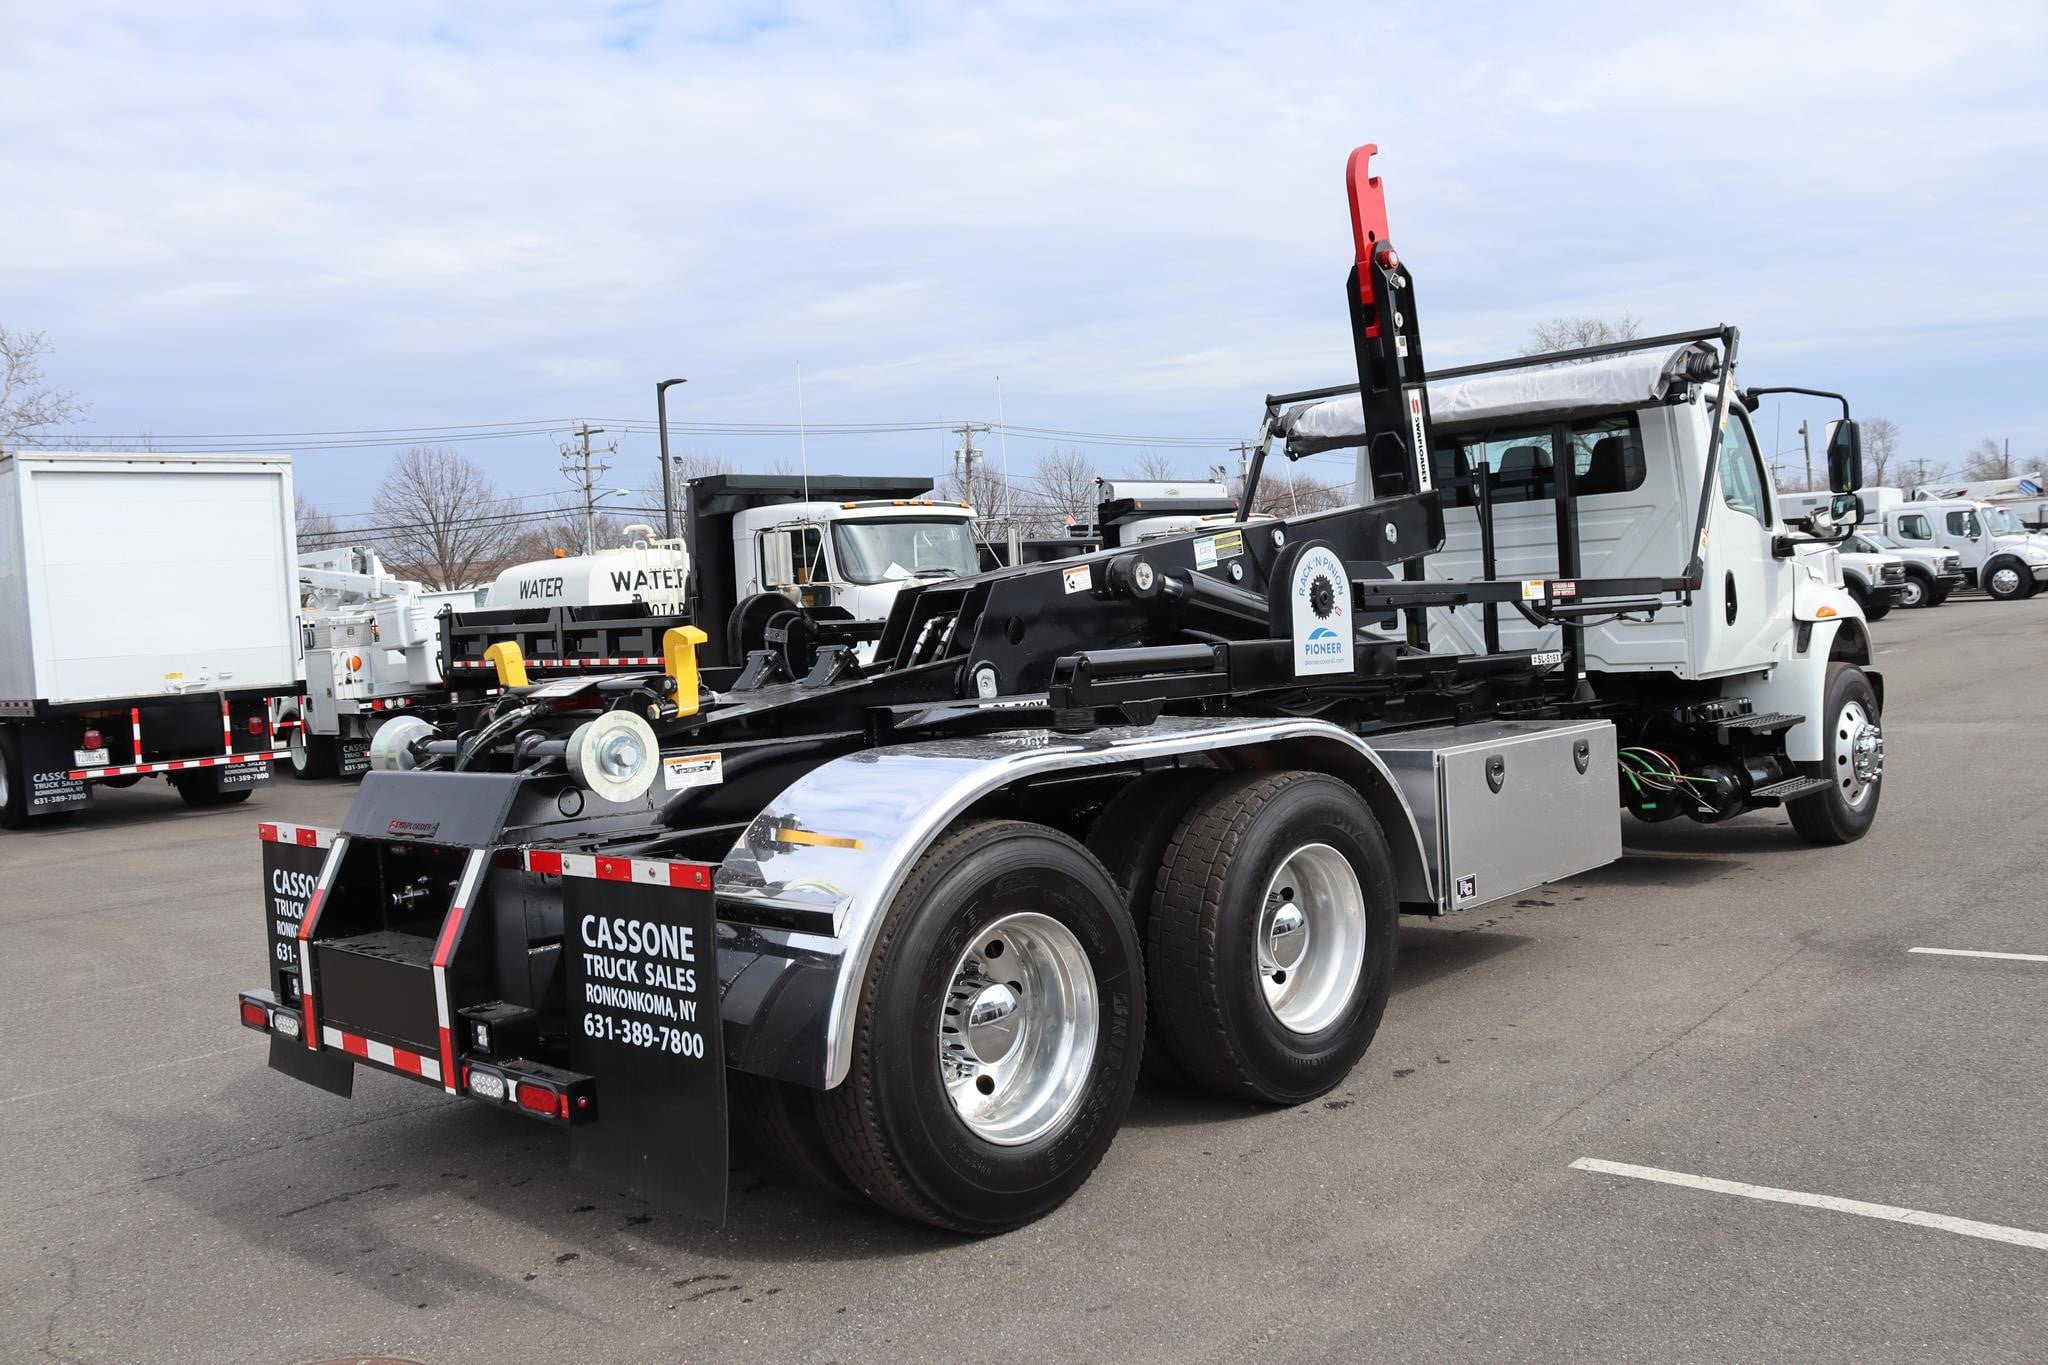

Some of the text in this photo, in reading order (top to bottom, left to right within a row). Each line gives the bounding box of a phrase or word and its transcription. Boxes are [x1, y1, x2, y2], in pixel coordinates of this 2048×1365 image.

[1299, 561, 1313, 597] RACK
[1323, 557, 1344, 596] PINION
[519, 577, 564, 600] WATER
[1305, 642, 1342, 655] PIONEER
[342, 743, 369, 753] CASSO
[33, 771, 67, 783] CASSO
[34, 782, 60, 790] TRUCK
[223, 772, 270, 783] 631-389-7800
[33, 792, 87, 805] 631-389-7800
[273, 868, 319, 899] CASSO
[276, 920, 299, 938] RONKO
[581, 914, 695, 962] CASSONE
[583, 953, 697, 993] TRUCK SALES
[585, 983, 697, 1022] RONKONKOMA, NY
[583, 1012, 704, 1060] 631-389-7800
